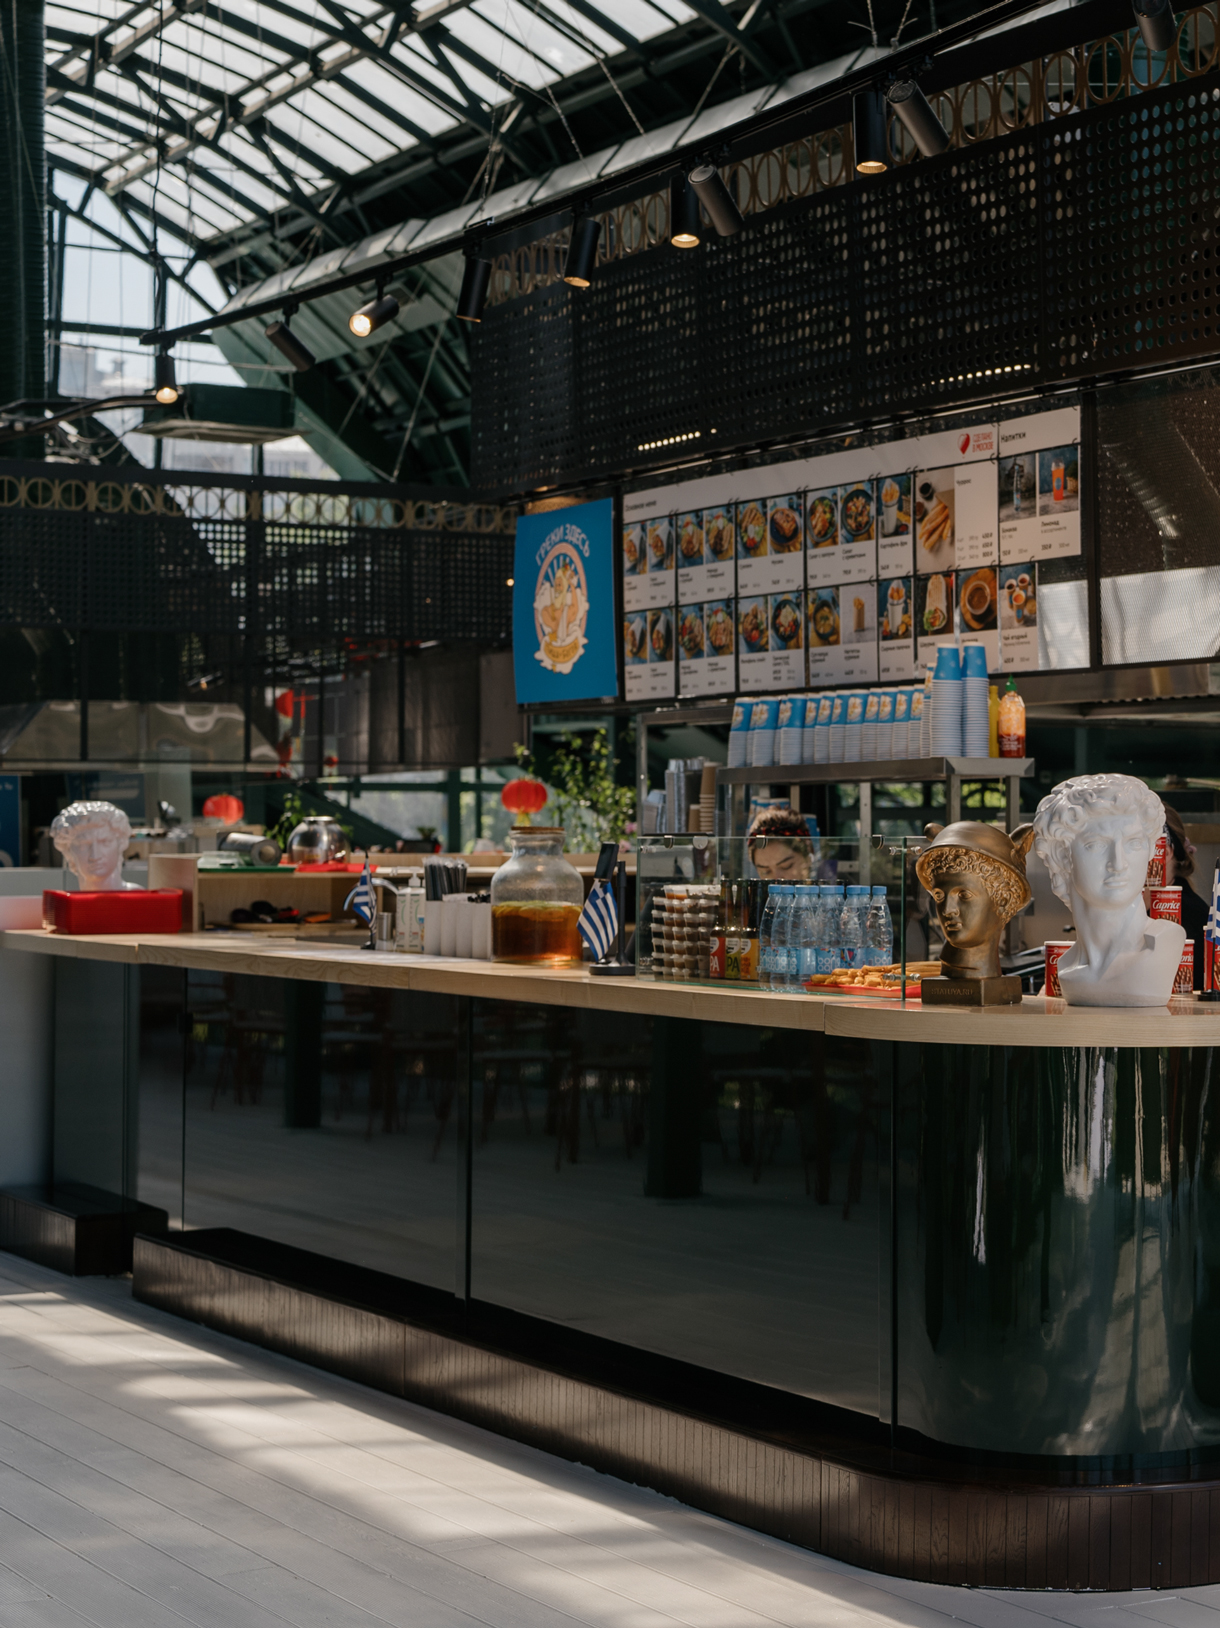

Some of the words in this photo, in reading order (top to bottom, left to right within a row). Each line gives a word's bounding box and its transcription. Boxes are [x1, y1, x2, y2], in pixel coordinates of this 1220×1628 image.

[1001, 432, 1026, 443] Напитки
[535, 524, 564, 566] ГРЕКИ
[564, 523, 590, 558] ЗДЕСЬ
[1152, 899, 1180, 911] Caprice
